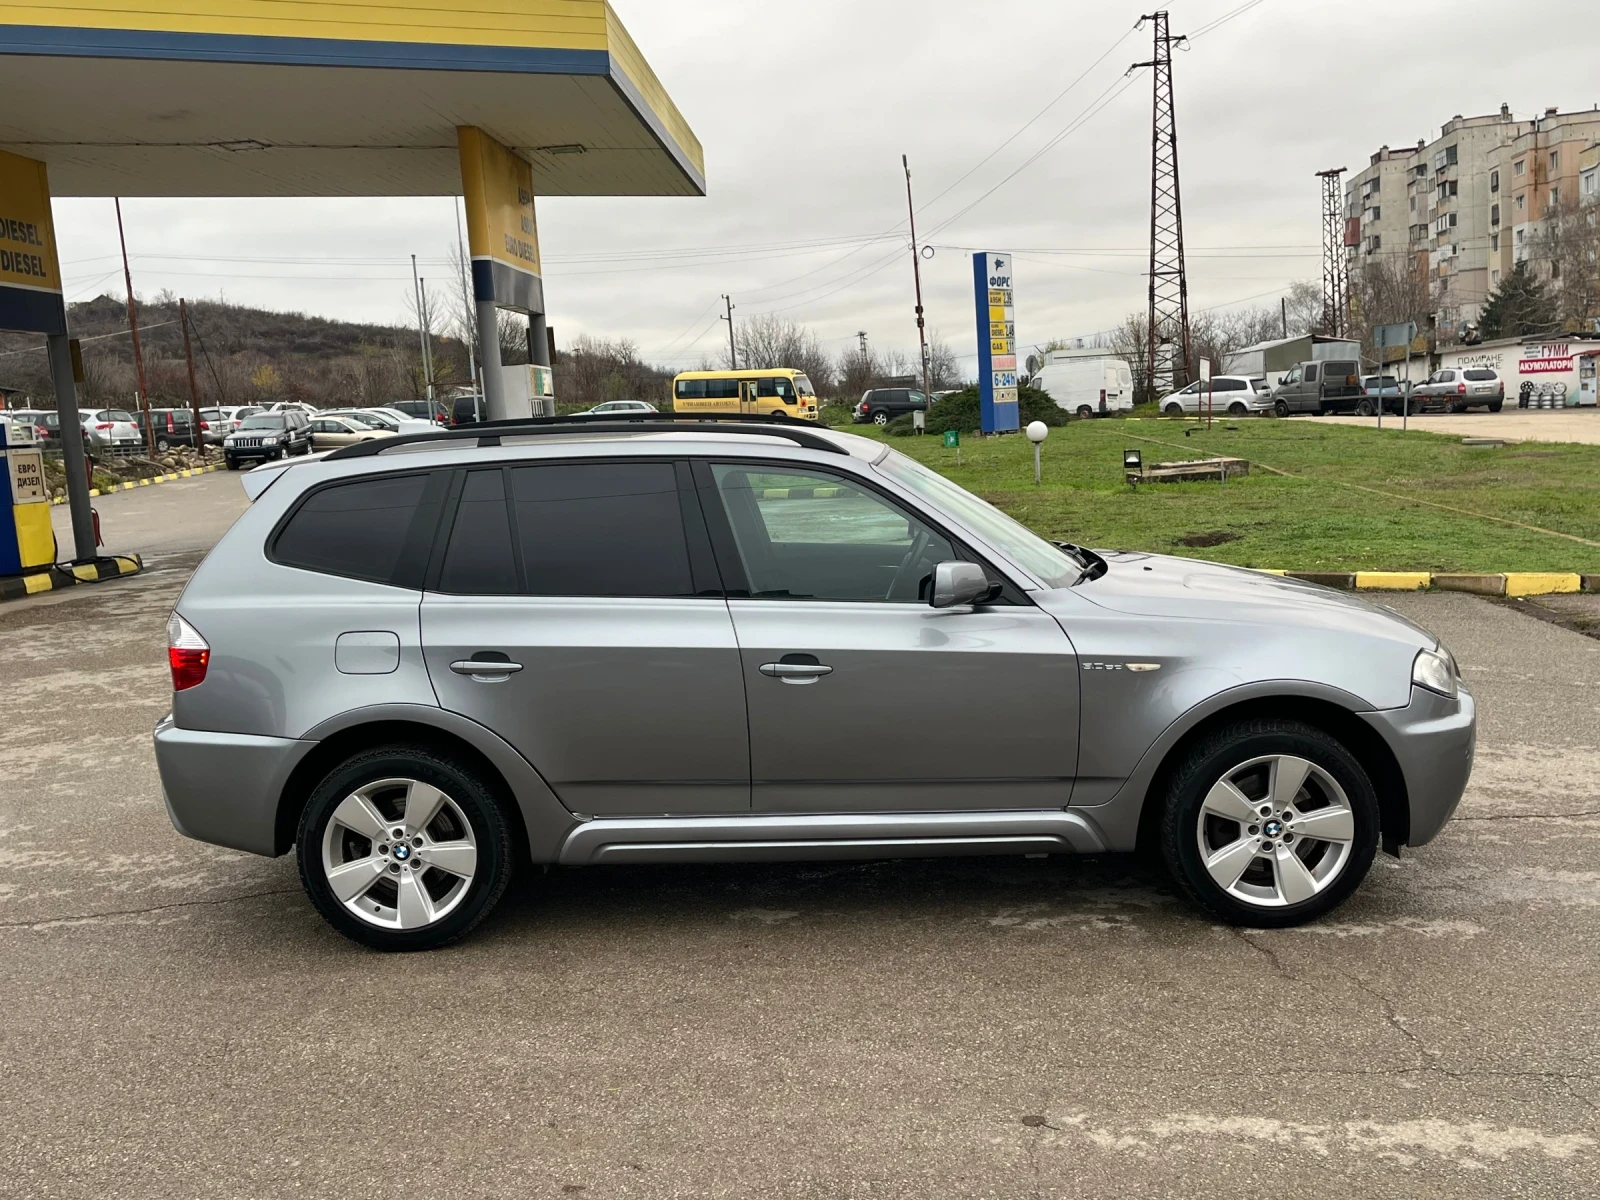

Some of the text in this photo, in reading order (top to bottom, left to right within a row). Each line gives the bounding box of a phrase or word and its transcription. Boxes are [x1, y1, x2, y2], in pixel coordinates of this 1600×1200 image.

[518, 240, 536, 264] DIESEL
[0, 250, 46, 277] DIESEL
[990, 276, 1010, 287] ФОРС
[992, 342, 1003, 350] GAS
[1541, 344, 1569, 357] ГУМИ
[1457, 353, 1504, 365] ПОЛИРАНЕ
[1519, 360, 1573, 371] АКУМУЛАТОРИ
[17, 464, 36, 474] ЕВРО
[17, 477, 40, 488] ДИЗЕЛ
